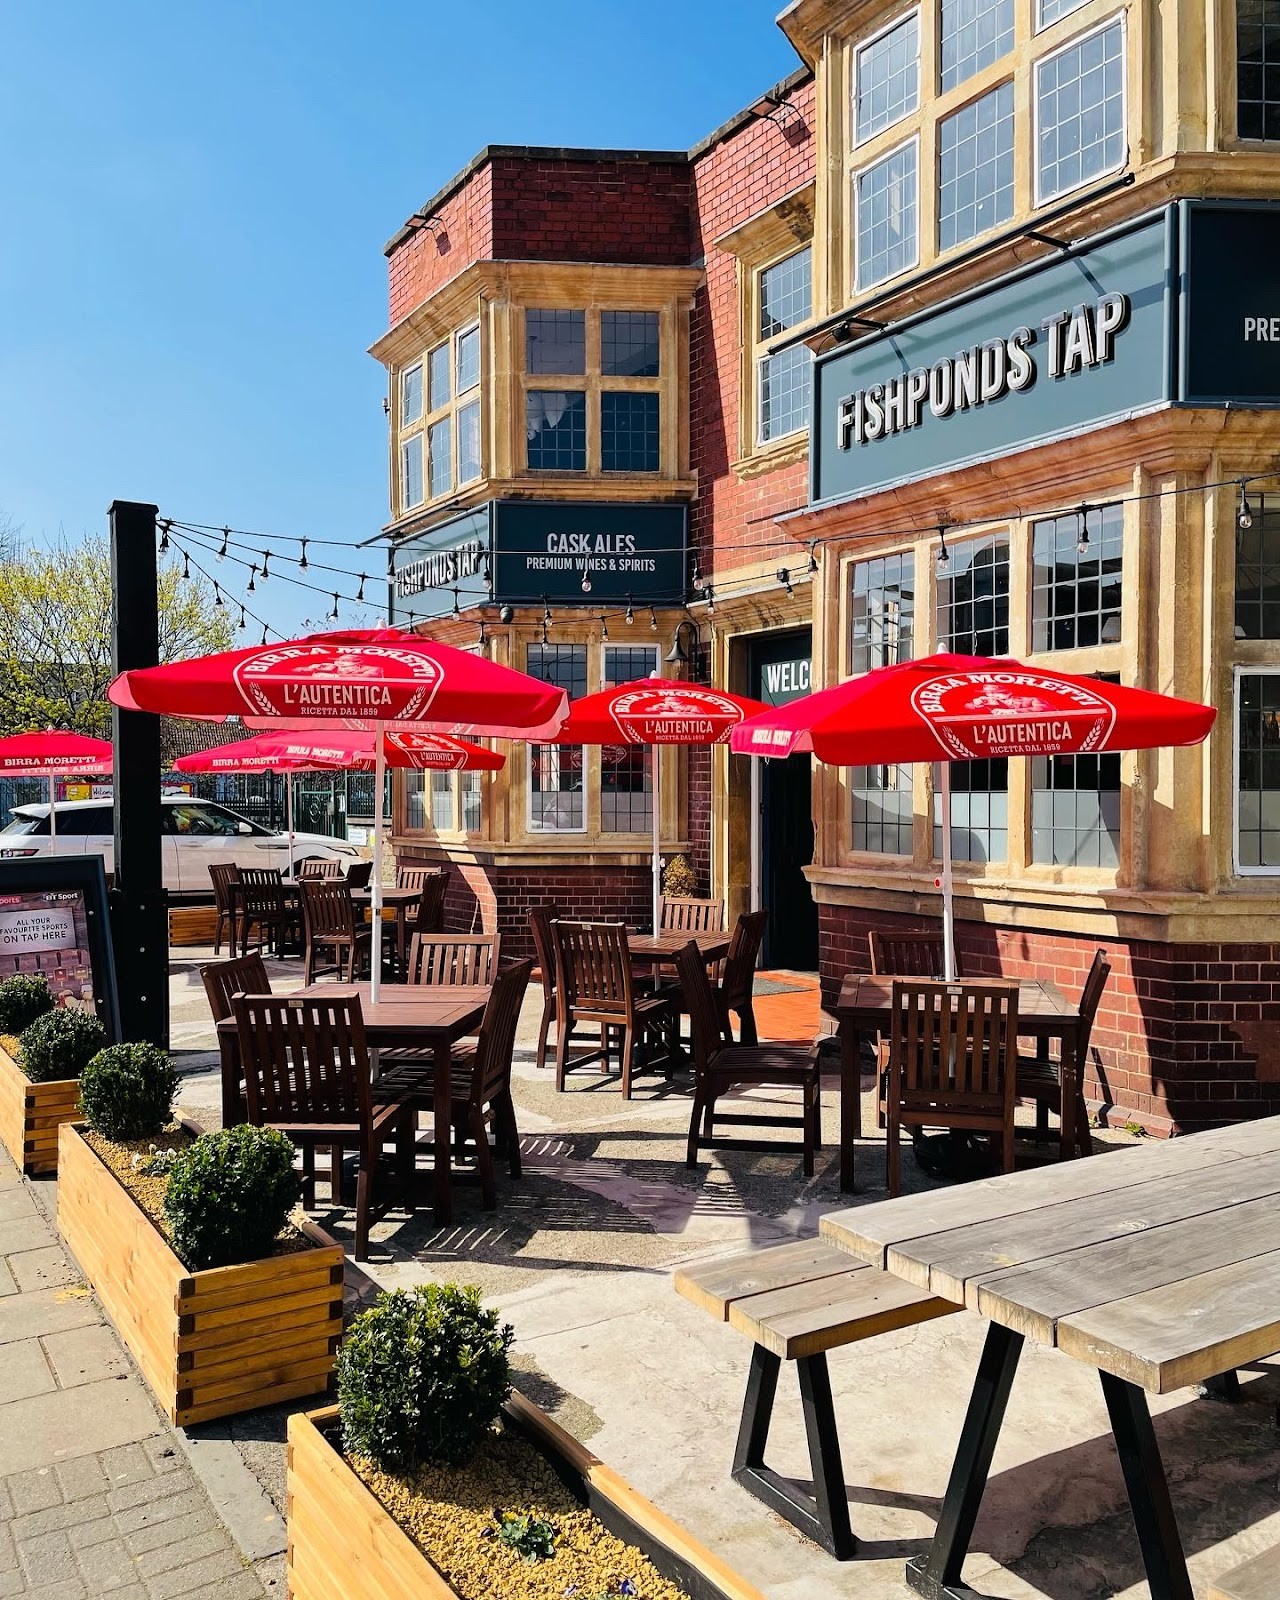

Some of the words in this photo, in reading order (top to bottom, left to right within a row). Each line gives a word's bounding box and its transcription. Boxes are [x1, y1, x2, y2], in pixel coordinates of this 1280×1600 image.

[837, 326, 1035, 450] FISHPONDS
[1041, 291, 1130, 380] TAP
[547, 533, 591, 553] CASK
[594, 534, 636, 555] ALES
[394, 548, 457, 598] FISHPONDS
[456, 540, 482, 577] TAP
[526, 557, 573, 570] PREMIUM
[575, 558, 607, 571] WINES
[609, 559, 617, 570] &
[619, 559, 656, 571] SPIRITS
[243, 647, 332, 673] BIRRA
[336, 647, 436, 678] MORETTI
[767, 661, 813, 693] WELC
[284, 684, 392, 705] L'AUTENTICA
[919, 677, 969, 713] BIRRA
[966, 673, 1103, 706] MORETTI
[614, 692, 656, 713] BIRRA
[657, 690, 738, 713] MORETTI
[301, 707, 338, 715] RICETTA
[340, 707, 357, 715] DAL
[360, 708, 378, 716] 1859
[645, 720, 713, 733] L'AUTENTICA
[973, 721, 1072, 744] L'AUTENTICA
[311, 747, 345, 758] MORETTI
[990, 745, 1023, 754] RICETTA
[1025, 744, 1042, 752] DAL
[1044, 743, 1060, 751] 1859
[4, 758, 40, 766] BIRRA
[44, 756, 96, 765] MORETTI
[212, 759, 240, 767] BIRRA
[241, 756, 279, 766] MORETTI
[58, 892, 78, 900] Sport
[0, 926, 39, 934] FAVOURITE
[42, 923, 68, 931] SPORTS
[4, 935, 18, 943] ON
[21, 934, 39, 942] TAP
[42, 931, 66, 940] HERE
